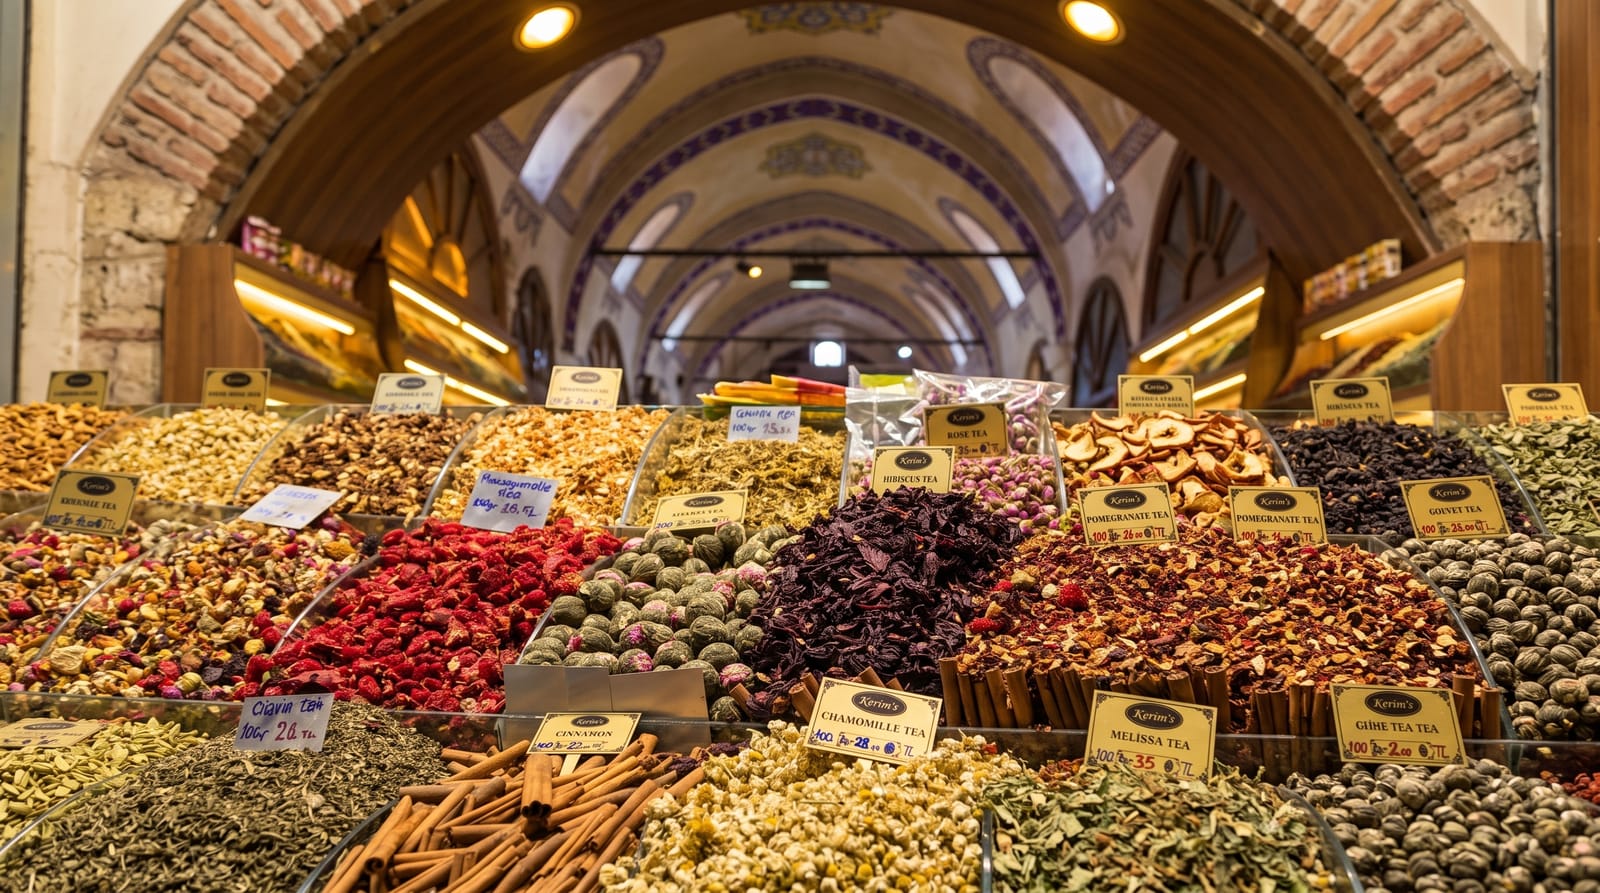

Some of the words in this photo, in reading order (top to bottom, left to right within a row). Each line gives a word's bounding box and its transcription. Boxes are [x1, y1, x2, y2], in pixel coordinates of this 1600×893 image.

[947, 430, 970, 439] ROSE
[971, 429, 988, 438] TEA
[899, 456, 928, 465] Kerim's
[883, 475, 921, 483] HIBISCUS
[922, 475, 938, 483] TEA
[1435, 489, 1466, 498] Kerim's
[1110, 495, 1140, 505] Kerim's
[1260, 497, 1291, 506] Kerim's
[1464, 505, 1482, 513] TEA
[1086, 511, 1152, 523] POMEGRANATE
[1151, 510, 1169, 519] TEA
[1236, 514, 1301, 524] POMEGRANATE
[1301, 516, 1319, 524] TEA
[1422, 524, 1436, 534] 100
[1092, 531, 1107, 542] 100
[1123, 529, 1134, 540] 26
[1241, 531, 1256, 541] 100
[859, 696, 900, 711] Kerim's
[1374, 698, 1414, 711] Kerim's
[1133, 709, 1176, 724] Kerim's
[821, 711, 901, 733] CHAMOMILLE
[903, 726, 926, 738] TEA
[1390, 722, 1414, 733] TEA
[1415, 723, 1439, 734] TEA
[814, 728, 833, 742] 100
[854, 736, 871, 750] 28
[1167, 738, 1191, 751] TEA
[1348, 740, 1368, 754] 100
[1432, 743, 1450, 759] TL
[1096, 748, 1115, 763] 100
[1133, 754, 1156, 770] 35
[1181, 760, 1195, 777] TL
